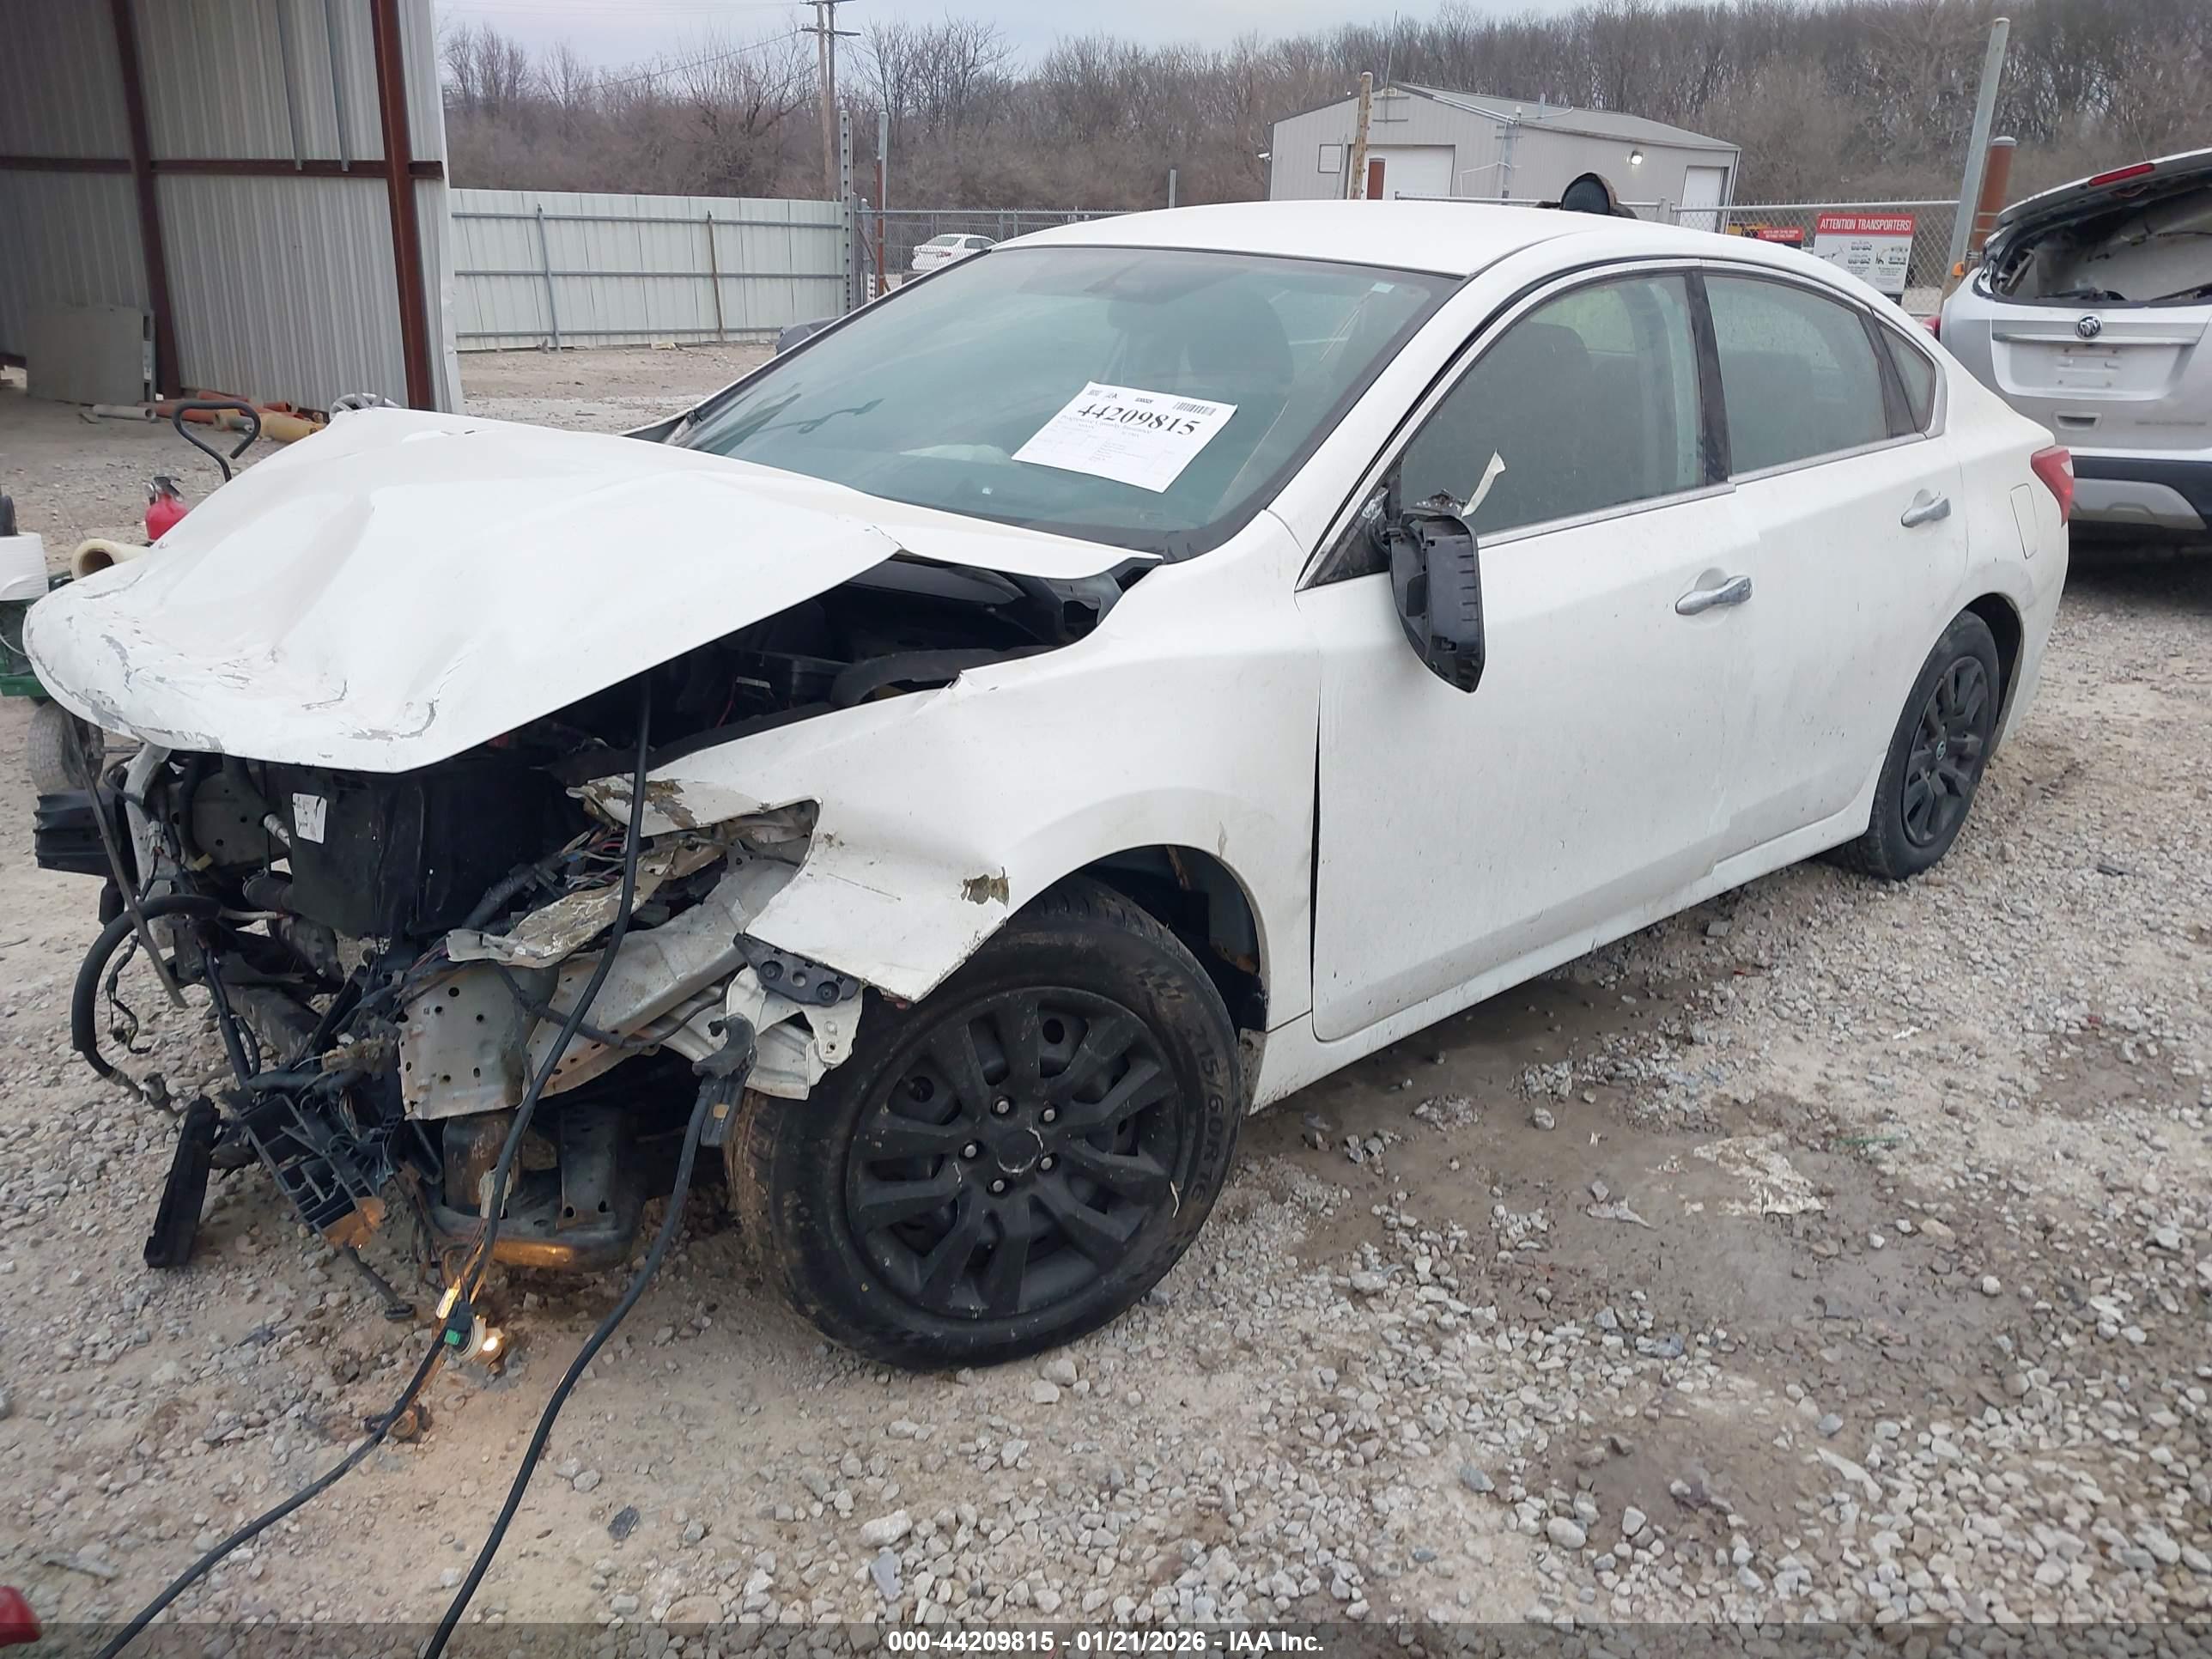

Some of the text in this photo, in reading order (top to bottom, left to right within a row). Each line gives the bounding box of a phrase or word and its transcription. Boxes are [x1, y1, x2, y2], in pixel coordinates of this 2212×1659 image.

[1820, 218, 1912, 231] ATTENTION TRANSPORTERS!
[1078, 403, 1201, 435] 44209815
